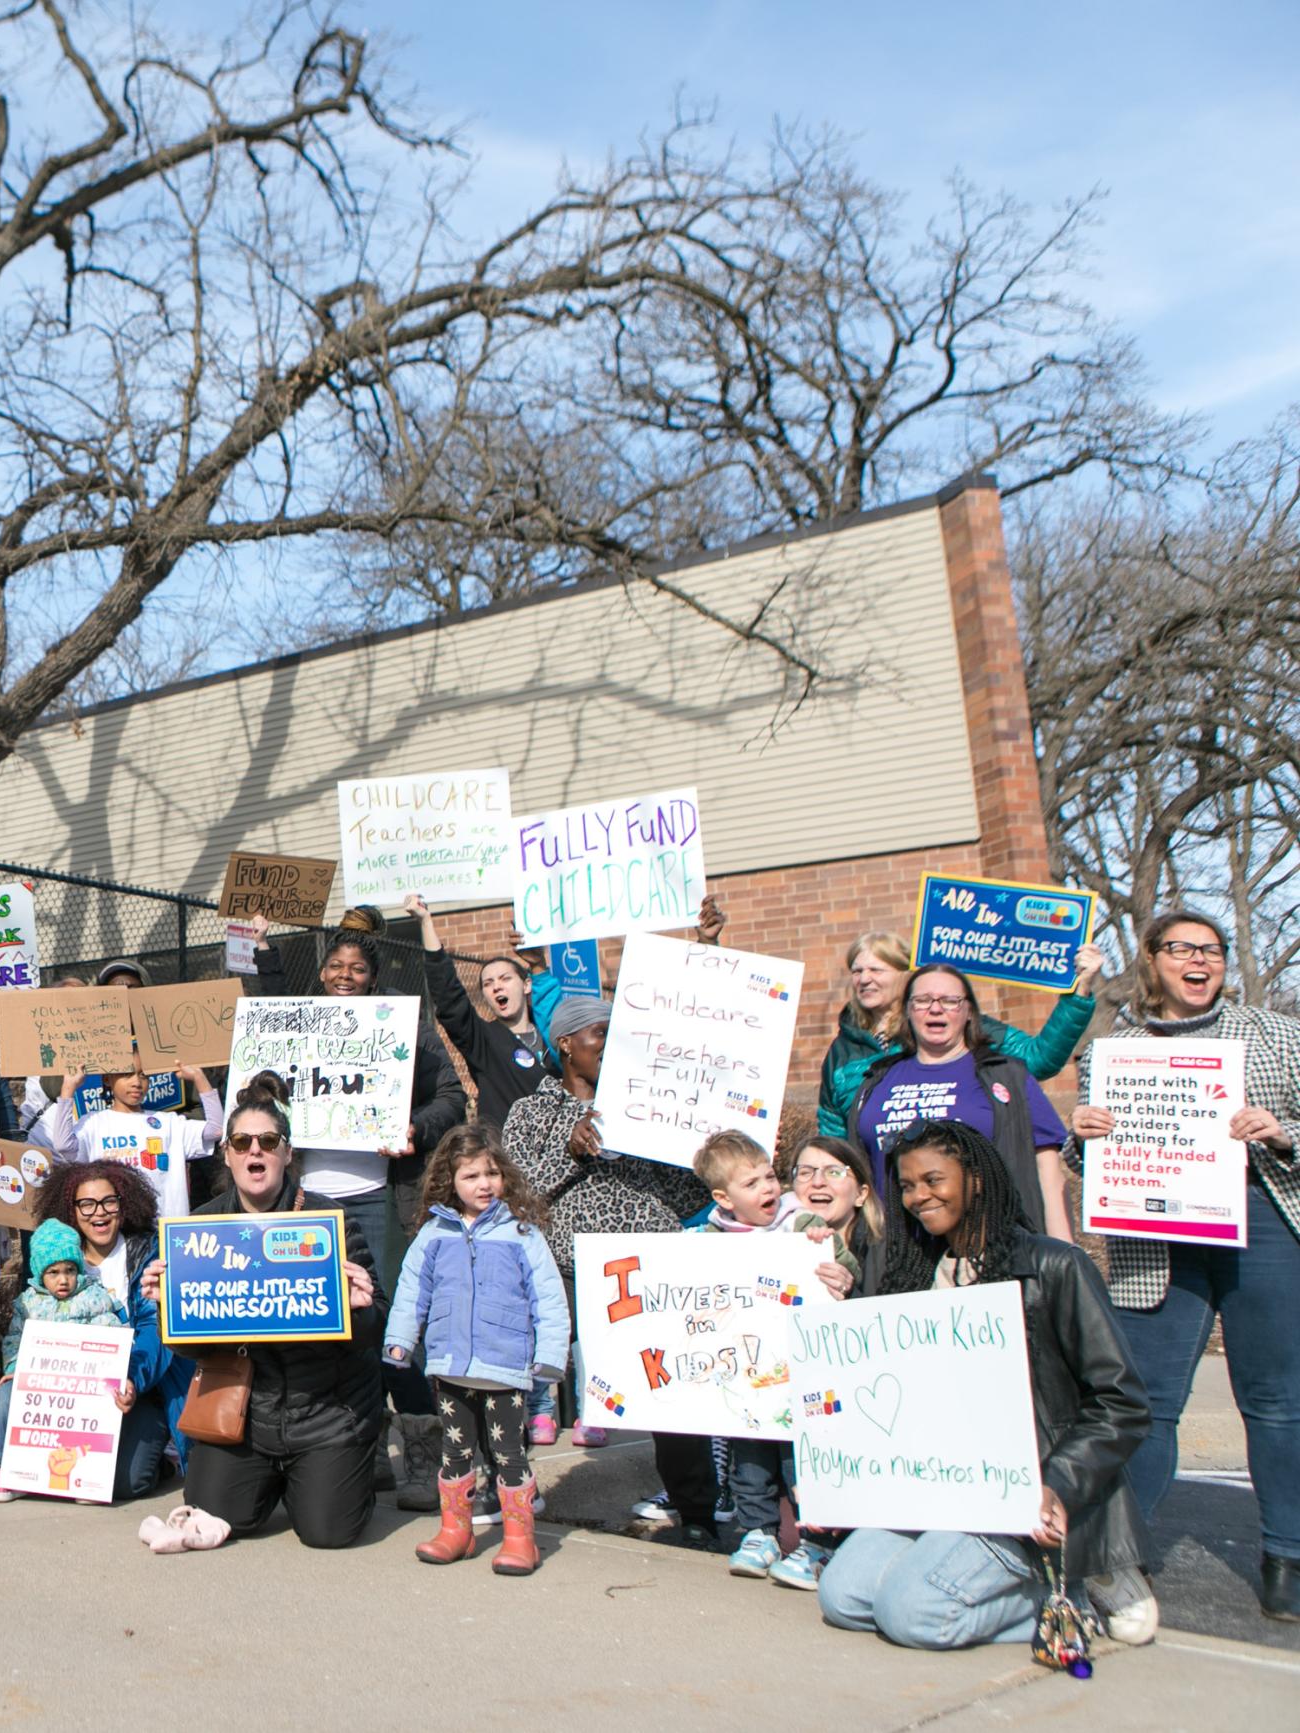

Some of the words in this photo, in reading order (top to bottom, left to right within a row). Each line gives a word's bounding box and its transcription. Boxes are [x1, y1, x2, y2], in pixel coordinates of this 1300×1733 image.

[353, 781, 502, 811] CHILDCARE
[471, 824, 497, 836] are
[358, 855, 397, 871] MORE
[268, 888, 300, 900] OUR
[352, 881, 386, 895] THAN
[523, 847, 700, 934] CHILDCARE
[941, 887, 976, 912] All
[974, 904, 1003, 927] In
[1026, 900, 1051, 910] KIDS
[932, 926, 961, 941] FOR
[964, 930, 996, 946] OUR
[1000, 935, 1071, 957] LITTLEST
[685, 943, 740, 974] Pay
[930, 941, 1068, 974] MINNESOTANS
[564, 977, 589, 986] PARKING
[750, 974, 771, 984] KIDS
[624, 983, 763, 1028] Childcare
[631, 1031, 760, 1080] Teachers
[1172, 1058, 1194, 1066] Child
[1196, 1059, 1218, 1067] Care
[647, 1058, 716, 1092] Fully
[1114, 1076, 1156, 1087] stand
[1162, 1077, 1198, 1088] with
[626, 1079, 699, 1106] Fund
[891, 1082, 957, 1092] CHILDREN
[921, 1089, 948, 1097] THE
[727, 1091, 748, 1102] KIDS
[882, 1095, 956, 1111] FUTURE
[1106, 1090, 1129, 1100] the
[1134, 1092, 1196, 1107] parents
[887, 1110, 917, 1121] AND
[919, 1107, 947, 1118] THE
[1106, 1104, 1132, 1114] and
[1137, 1105, 1175, 1116] child
[1181, 1109, 1218, 1118] care
[624, 1104, 723, 1136] Childca
[1115, 1118, 1180, 1131] roviders
[102, 1135, 137, 1149] KIDS
[1172, 1135, 1195, 1146] for
[1116, 1146, 1151, 1160] fully
[1157, 1149, 1215, 1162] funded
[1103, 1160, 1140, 1172] child
[1146, 1165, 1181, 1175] care
[1103, 1175, 1166, 1188] system.
[272, 1232, 297, 1241] KIDS
[184, 1232, 220, 1259] All
[222, 1245, 251, 1271] In
[180, 1282, 212, 1298] FOR
[215, 1280, 249, 1297] OUR
[253, 1277, 327, 1296] LITTLEST
[604, 1256, 753, 1323] INVEST
[758, 1276, 780, 1288] KIDS
[181, 1296, 329, 1320] MINNESOTANS
[685, 1315, 716, 1335] in
[897, 1314, 940, 1350] Our
[951, 1305, 1006, 1350] Kids
[40, 1359, 78, 1372] WORK
[84, 1362, 96, 1374] IN
[639, 1334, 761, 1391] KIDS!
[27, 1375, 106, 1395] CHILDCARE
[592, 1375, 611, 1392] KIDS
[25, 1393, 41, 1406] SO
[49, 1396, 75, 1409] YOU
[804, 1392, 821, 1403] KIDS
[22, 1411, 51, 1426] CAN
[57, 1416, 74, 1428] GO
[81, 1418, 98, 1431] TO
[19, 1430, 62, 1447] WORK.
[800, 1432, 863, 1489] Apoyar
[869, 1460, 881, 1474] a
[891, 1456, 974, 1483] nuestros
[983, 1459, 1031, 1500] hijos
